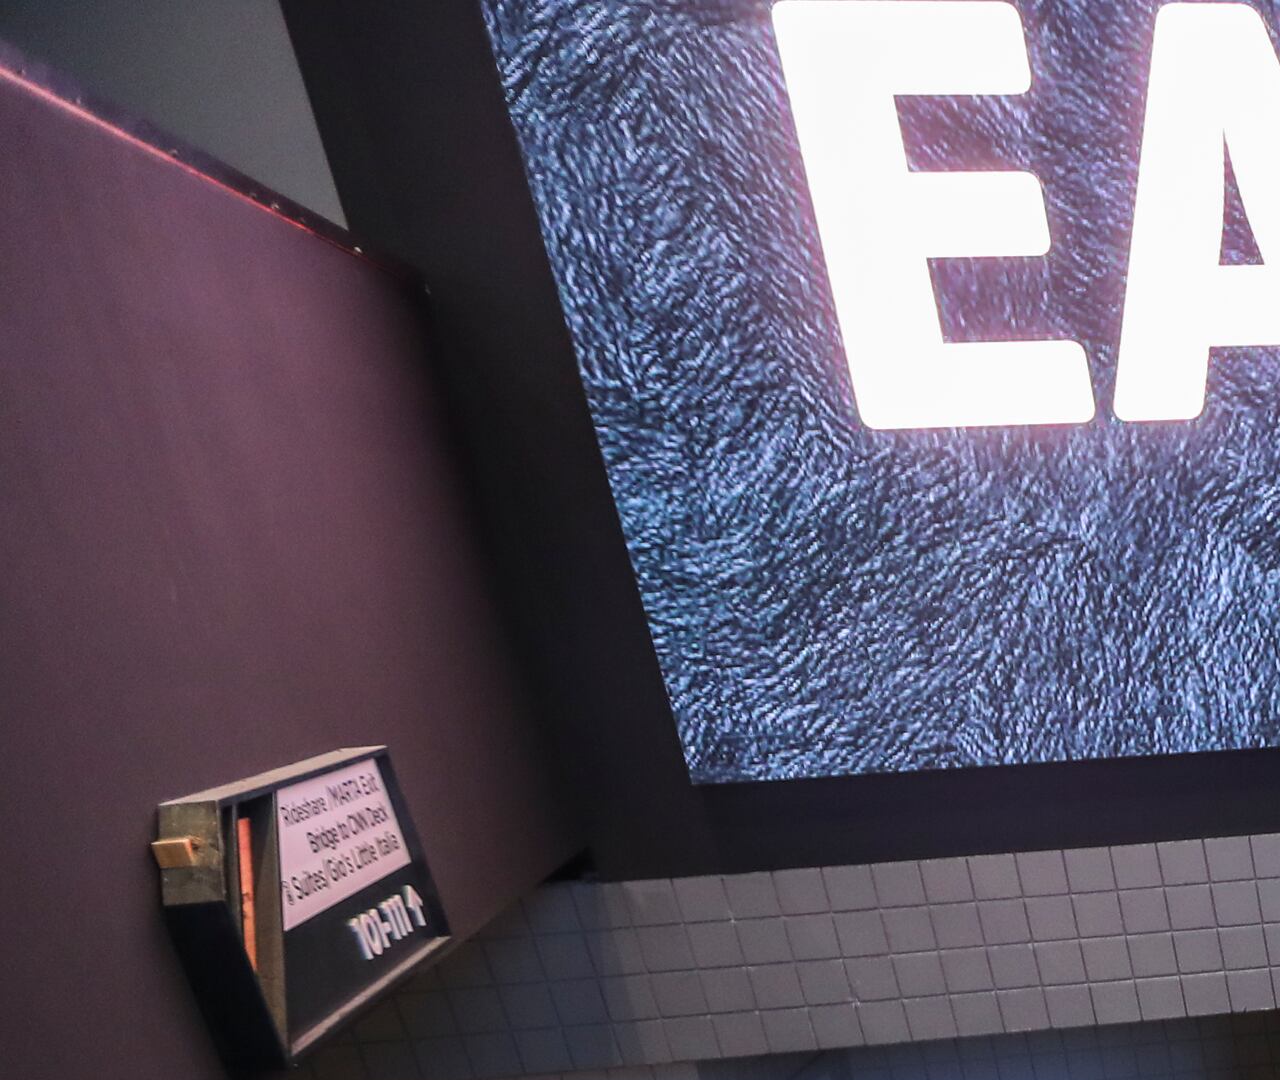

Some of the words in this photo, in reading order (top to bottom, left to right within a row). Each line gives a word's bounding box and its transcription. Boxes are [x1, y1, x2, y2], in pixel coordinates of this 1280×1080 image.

[359, 771, 380, 796] Exit
[306, 826, 341, 853] Bridge
[365, 801, 389, 827] Deck
[350, 842, 378, 869] Little
[347, 894, 414, 960] 101-111
